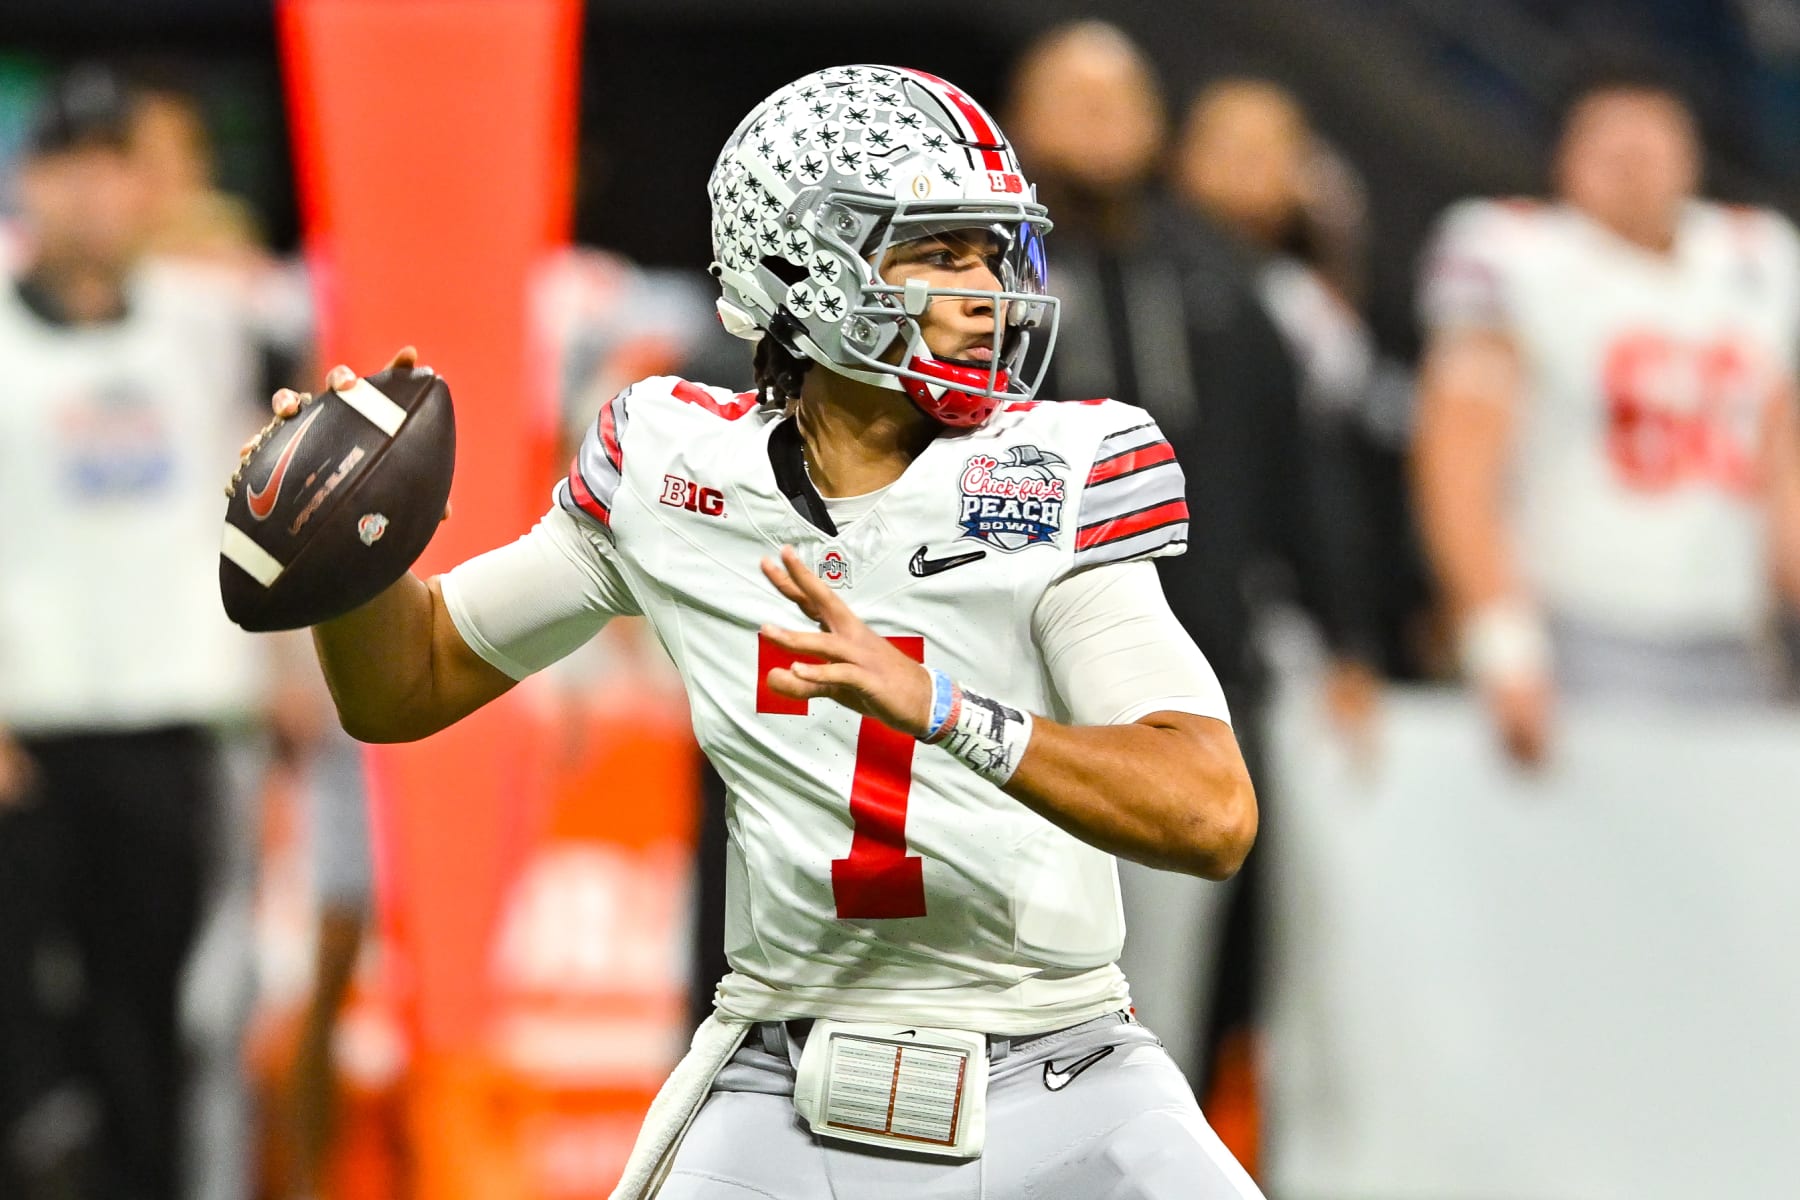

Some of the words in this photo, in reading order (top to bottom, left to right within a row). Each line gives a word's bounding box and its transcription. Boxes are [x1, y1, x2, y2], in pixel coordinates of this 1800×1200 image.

[963, 458, 1064, 501] Chick-fil-A
[961, 496, 1060, 529] PEACH
[979, 521, 1038, 534] BOWL
[756, 632, 927, 920] 7
